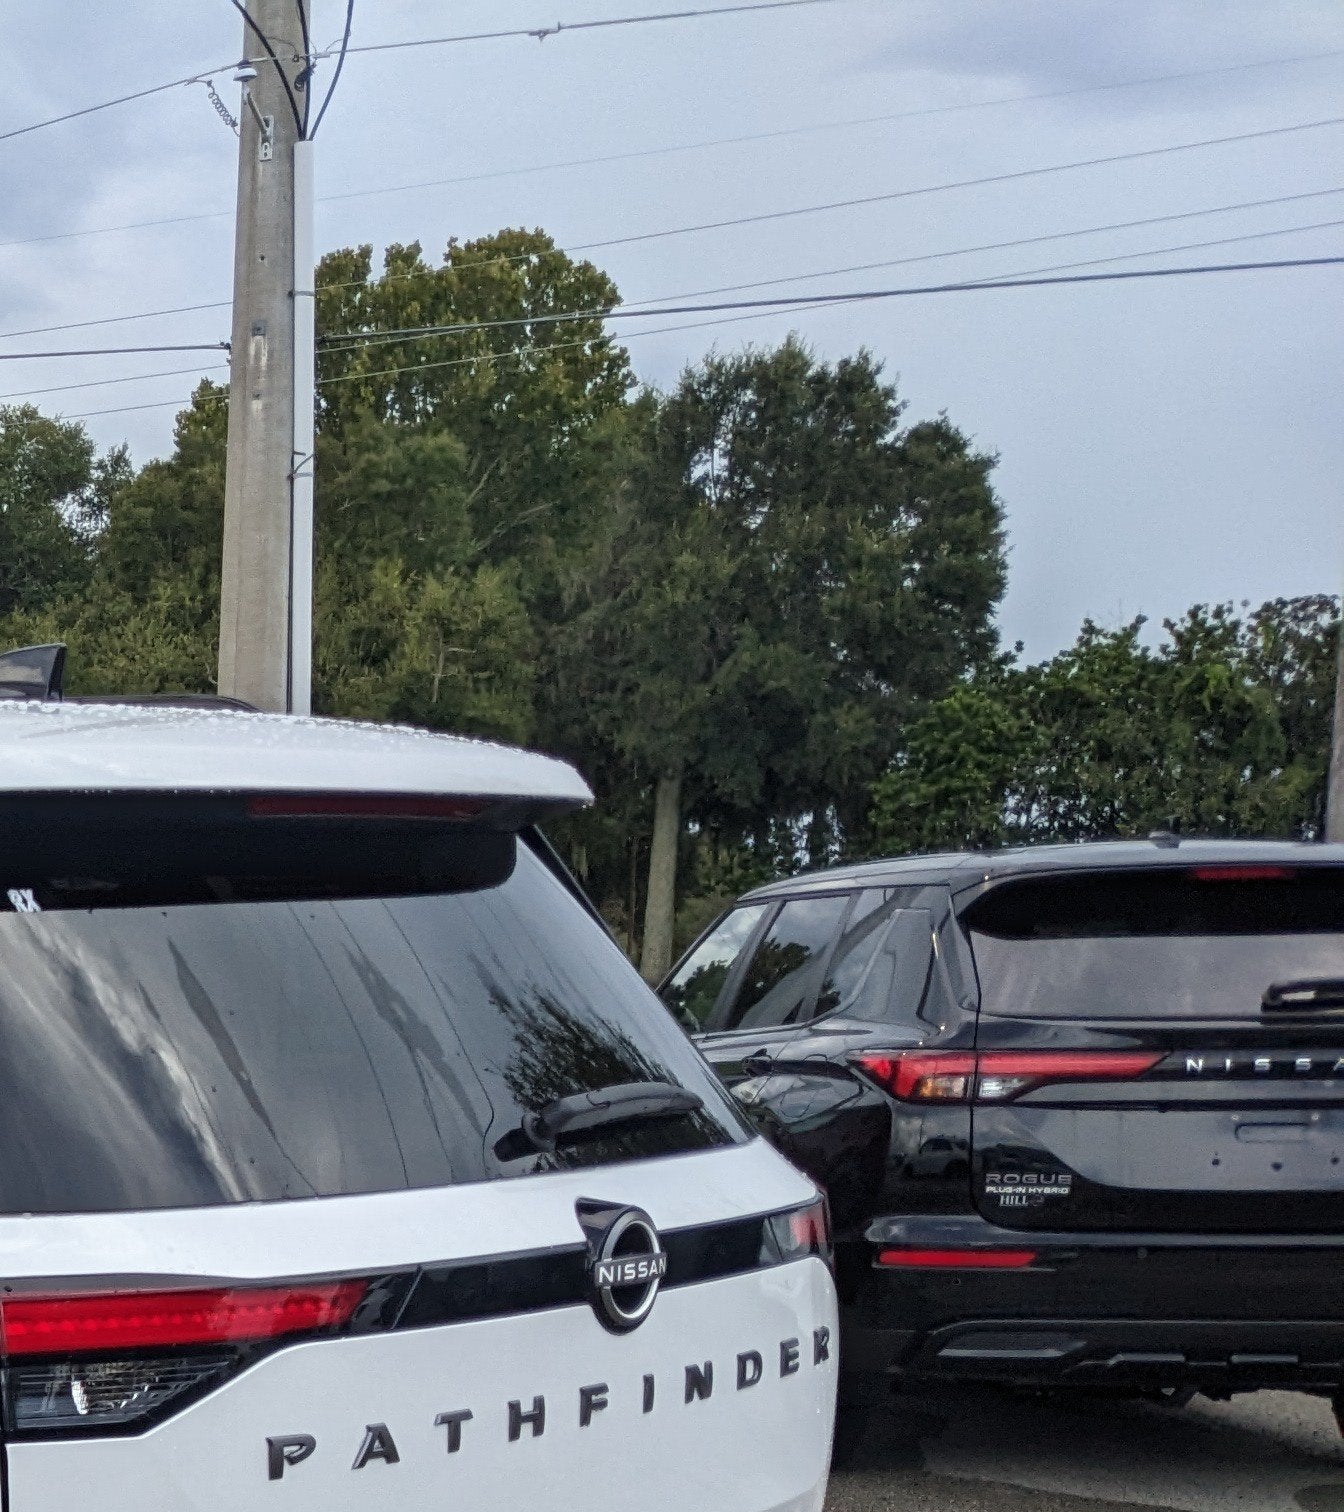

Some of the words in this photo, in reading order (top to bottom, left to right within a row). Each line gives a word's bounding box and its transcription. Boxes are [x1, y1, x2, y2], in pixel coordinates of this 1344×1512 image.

[985, 1173, 1072, 1184] ROGUE
[985, 1185, 1027, 1194] PLUG-IN
[1028, 1186, 1070, 1194] HYBRID
[999, 1194, 1029, 1207] HILL
[598, 1257, 667, 1283] NISSAN
[265, 1325, 831, 1481] PATHFINDER
